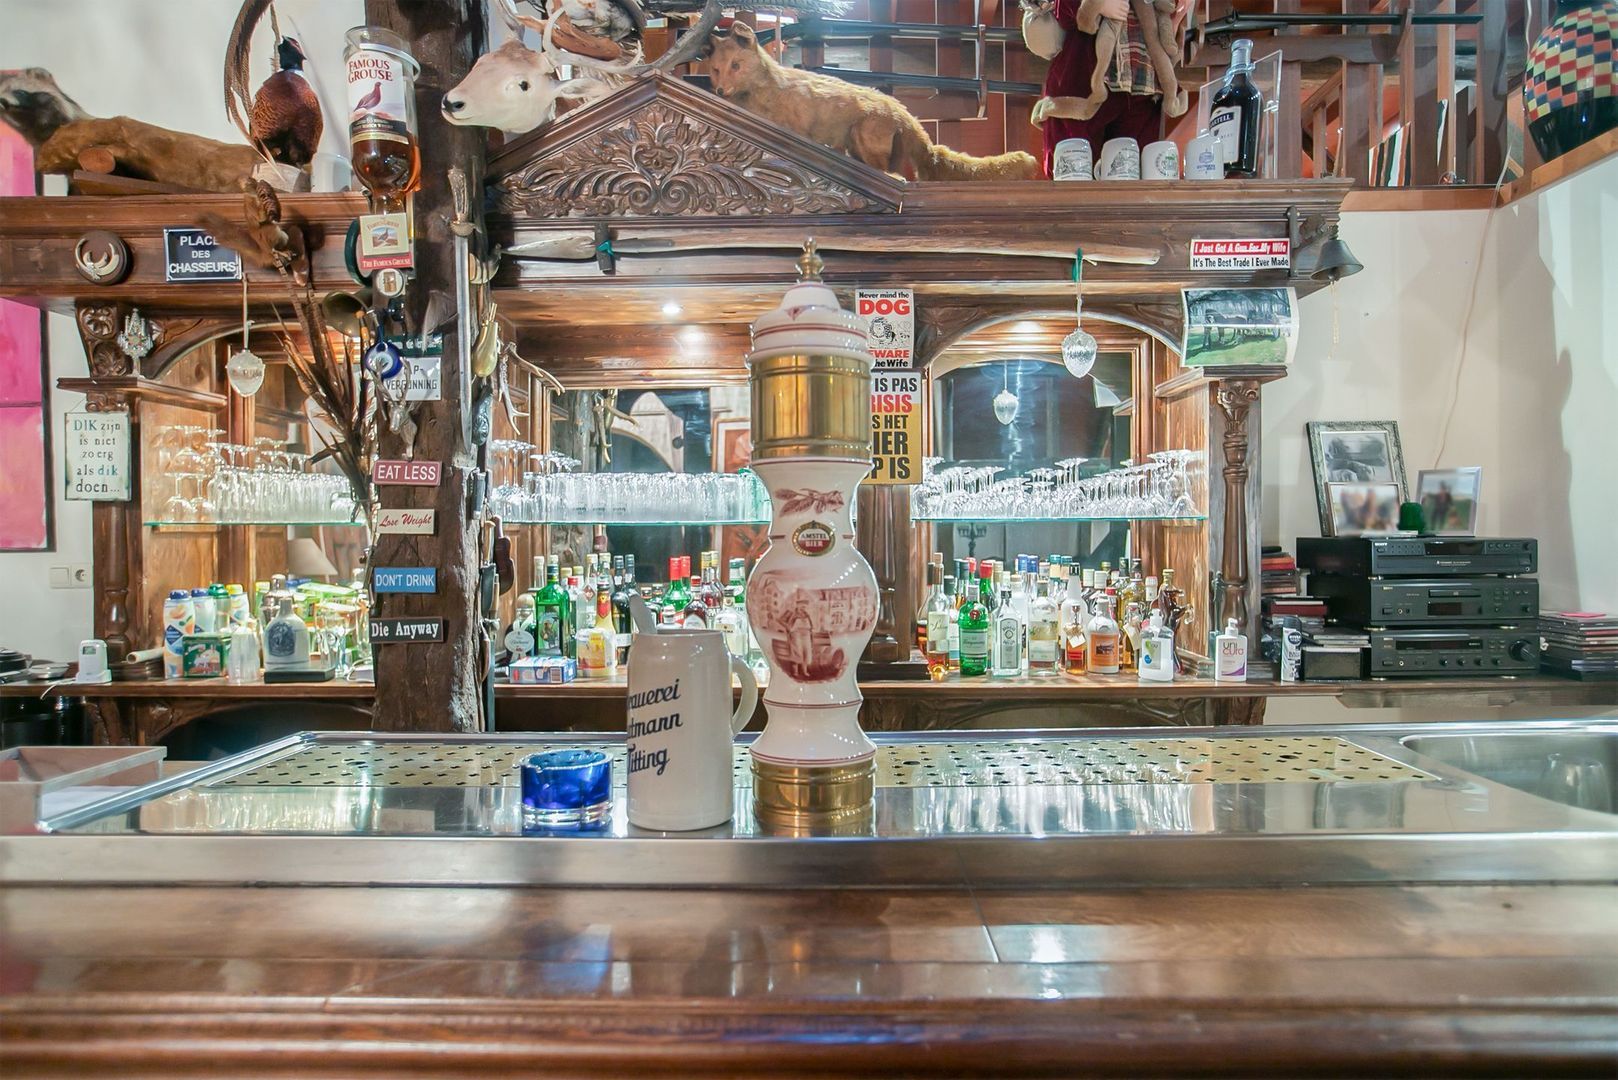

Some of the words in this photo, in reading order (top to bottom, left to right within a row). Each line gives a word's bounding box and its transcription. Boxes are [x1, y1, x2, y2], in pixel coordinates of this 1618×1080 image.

[348, 59, 390, 73] FAMOUS
[348, 69, 393, 84] GROUSE
[1210, 113, 1231, 127] ARTELL
[1199, 243, 1214, 253] Just
[1215, 243, 1226, 253] Got
[1227, 243, 1233, 252] A
[1272, 242, 1287, 253] Wife
[191, 250, 211, 259] DES
[169, 262, 236, 273] CHASSEURS
[1193, 257, 1203, 267] It's
[1205, 257, 1216, 267] The
[1217, 257, 1232, 267] Best
[1233, 257, 1250, 267] Trade
[1255, 257, 1270, 267] Ever
[1271, 256, 1289, 266] Made
[859, 291, 879, 299] Never
[859, 299, 910, 315] DOG
[868, 350, 910, 358] EWARE
[875, 359, 886, 367] he
[886, 359, 909, 367] Wife
[874, 378, 888, 392] IS
[892, 378, 917, 392] PAS
[871, 394, 912, 413] RISIS
[74, 420, 97, 431] DIK
[884, 415, 908, 429] HET
[80, 434, 89, 445] is
[95, 434, 116, 445] niet
[873, 431, 909, 455] IER
[97, 451, 113, 461] erg
[77, 464, 94, 475] als
[98, 465, 117, 475] dik
[378, 465, 401, 479] EAT
[404, 465, 436, 480] LESS
[864, 457, 884, 479] P
[889, 457, 911, 479] IS
[379, 515, 399, 527] Lose
[401, 513, 432, 528] Weight
[376, 574, 403, 586] DON'T
[406, 574, 434, 587] DRINK
[371, 622, 389, 637] Die
[395, 622, 439, 639] Anyway
